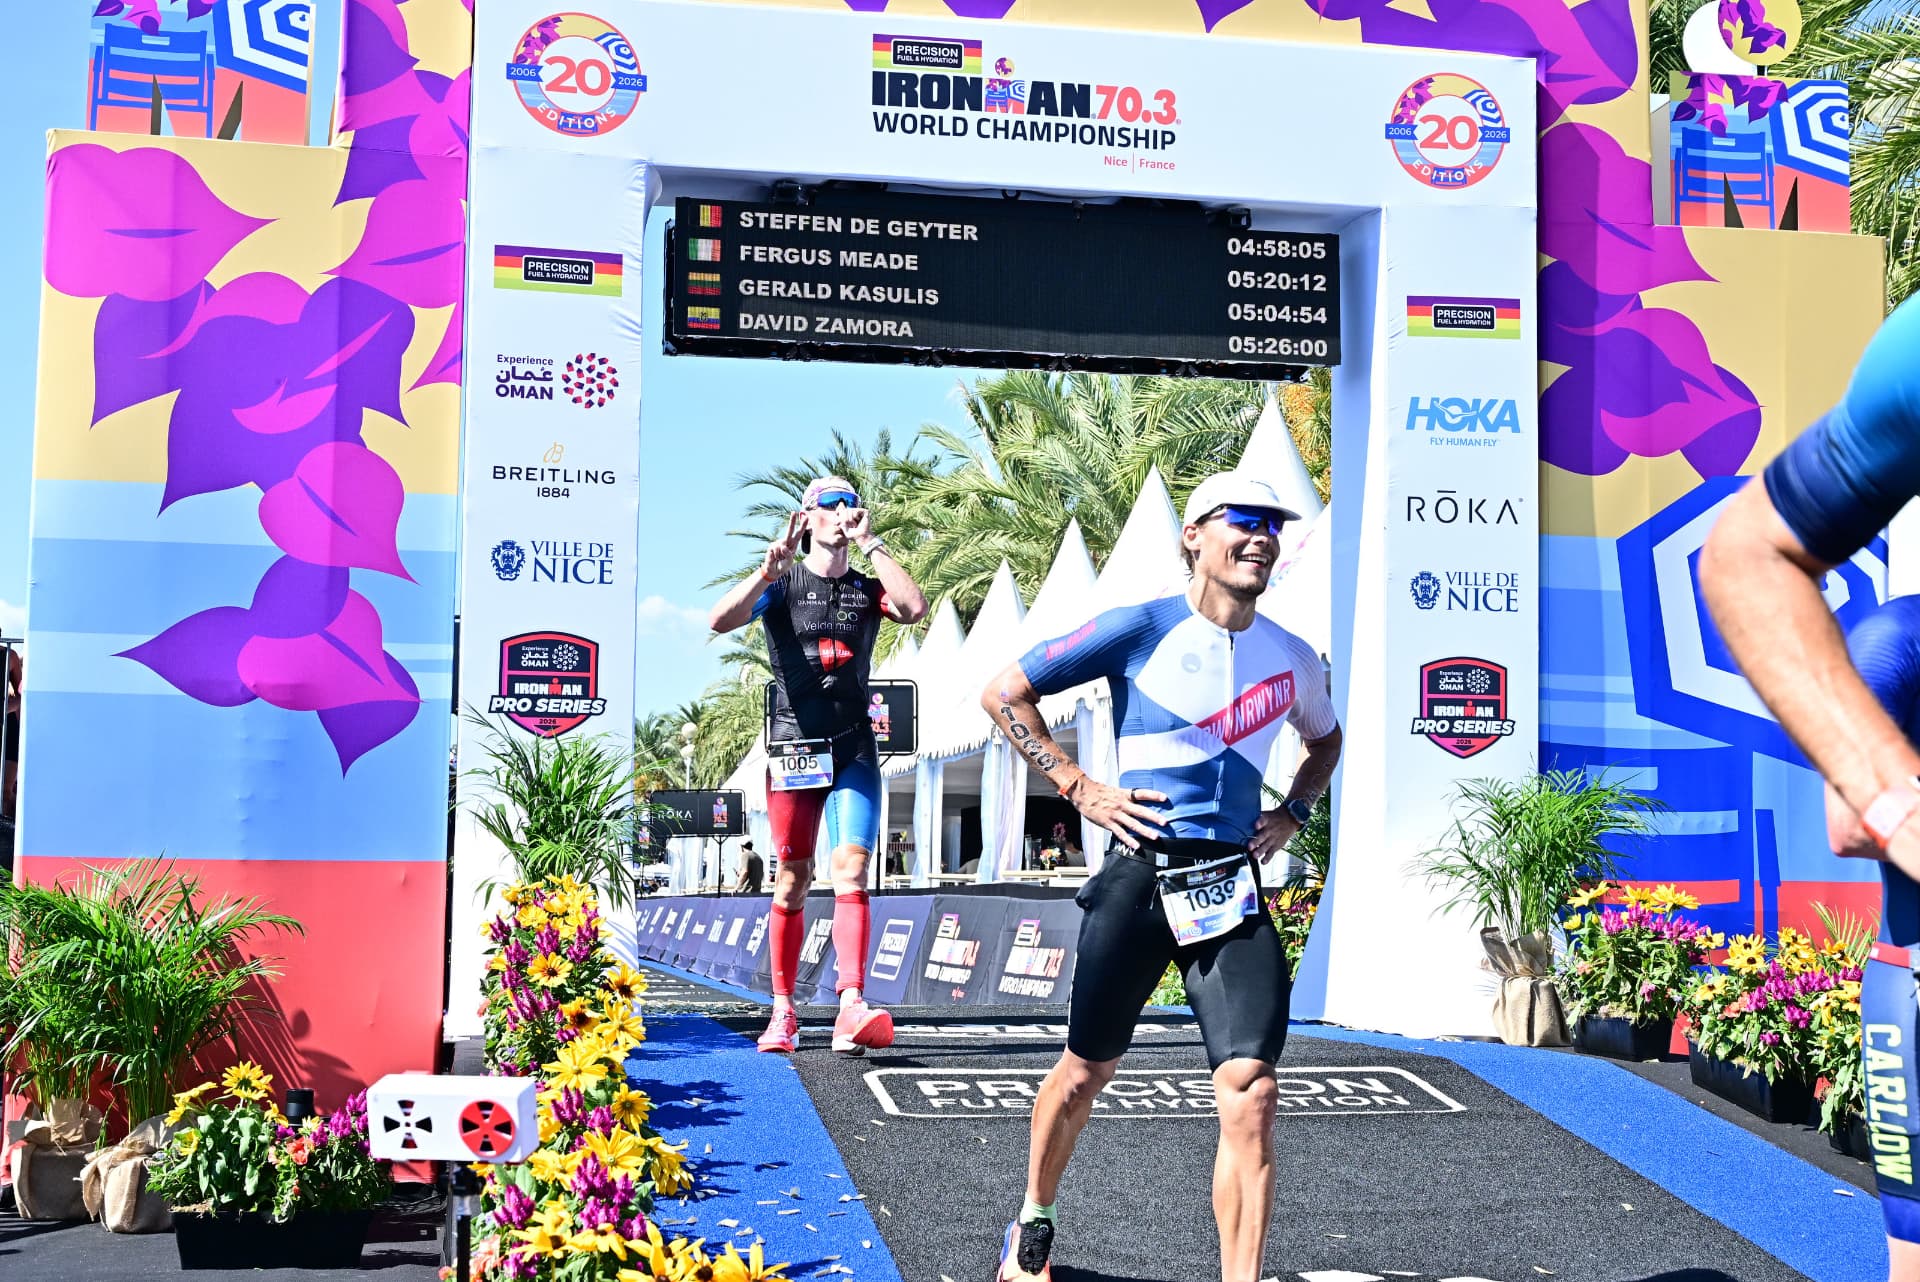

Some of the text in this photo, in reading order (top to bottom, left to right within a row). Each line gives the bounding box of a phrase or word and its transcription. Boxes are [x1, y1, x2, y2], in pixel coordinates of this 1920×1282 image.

[897, 44, 958, 57] PRECISION
[897, 54, 914, 62] FUEL
[921, 56, 958, 64] HYDRATION
[511, 67, 536, 77] 2006
[544, 56, 611, 96] 20
[618, 77, 643, 87] 2026
[872, 70, 1177, 125] IRONMAN 70.3
[537, 102, 616, 129] EDITIONS
[872, 111, 1176, 150] WORLD CHAMPIONSHIP
[1388, 128, 1411, 136] 2006
[1419, 114, 1478, 150] 20
[1484, 130, 1506, 138] 2026
[1104, 156, 1175, 170] Nice France
[1412, 159, 1483, 182] EDITIONS
[740, 212, 1326, 259] STEFFEN DE GEYTER 04:58:05
[528, 262, 588, 274] PRECISION
[528, 270, 544, 278] FUEL
[740, 245, 1326, 292] FERGUS MEADE 05:20:12
[739, 279, 1328, 324] GERALD KASULIS 05:04:54
[1437, 309, 1491, 320] PRECISION
[739, 313, 1328, 356] DAVID ZAMORA 05:26:00
[496, 354, 554, 366] Experience
[496, 384, 553, 400] OMAN
[1406, 396, 1520, 433] HOKA
[1430, 437, 1497, 446] FLY HUMAN FLY
[492, 466, 616, 484] BREITLING
[537, 486, 570, 498] 1884
[531, 540, 614, 558] VILLE DE
[532, 557, 614, 584] NICE
[1445, 571, 1518, 588] VILLE DE
[1446, 587, 1518, 612] NICE
[521, 660, 548, 668] OMAN
[514, 682, 583, 696] IRONMAN
[490, 697, 603, 714] PRO SERIES
[1433, 706, 1494, 717] IRONMAN
[1412, 720, 1514, 734] PRO SERIES
[780, 755, 818, 771] 1005
[1184, 880, 1236, 912] 1039
[916, 1077, 1392, 1096] PRCISON
[928, 1098, 1034, 1108] FUE
[1112, 1096, 1410, 1109] HYDTION
[1865, 1024, 1912, 1185] CARLOW
